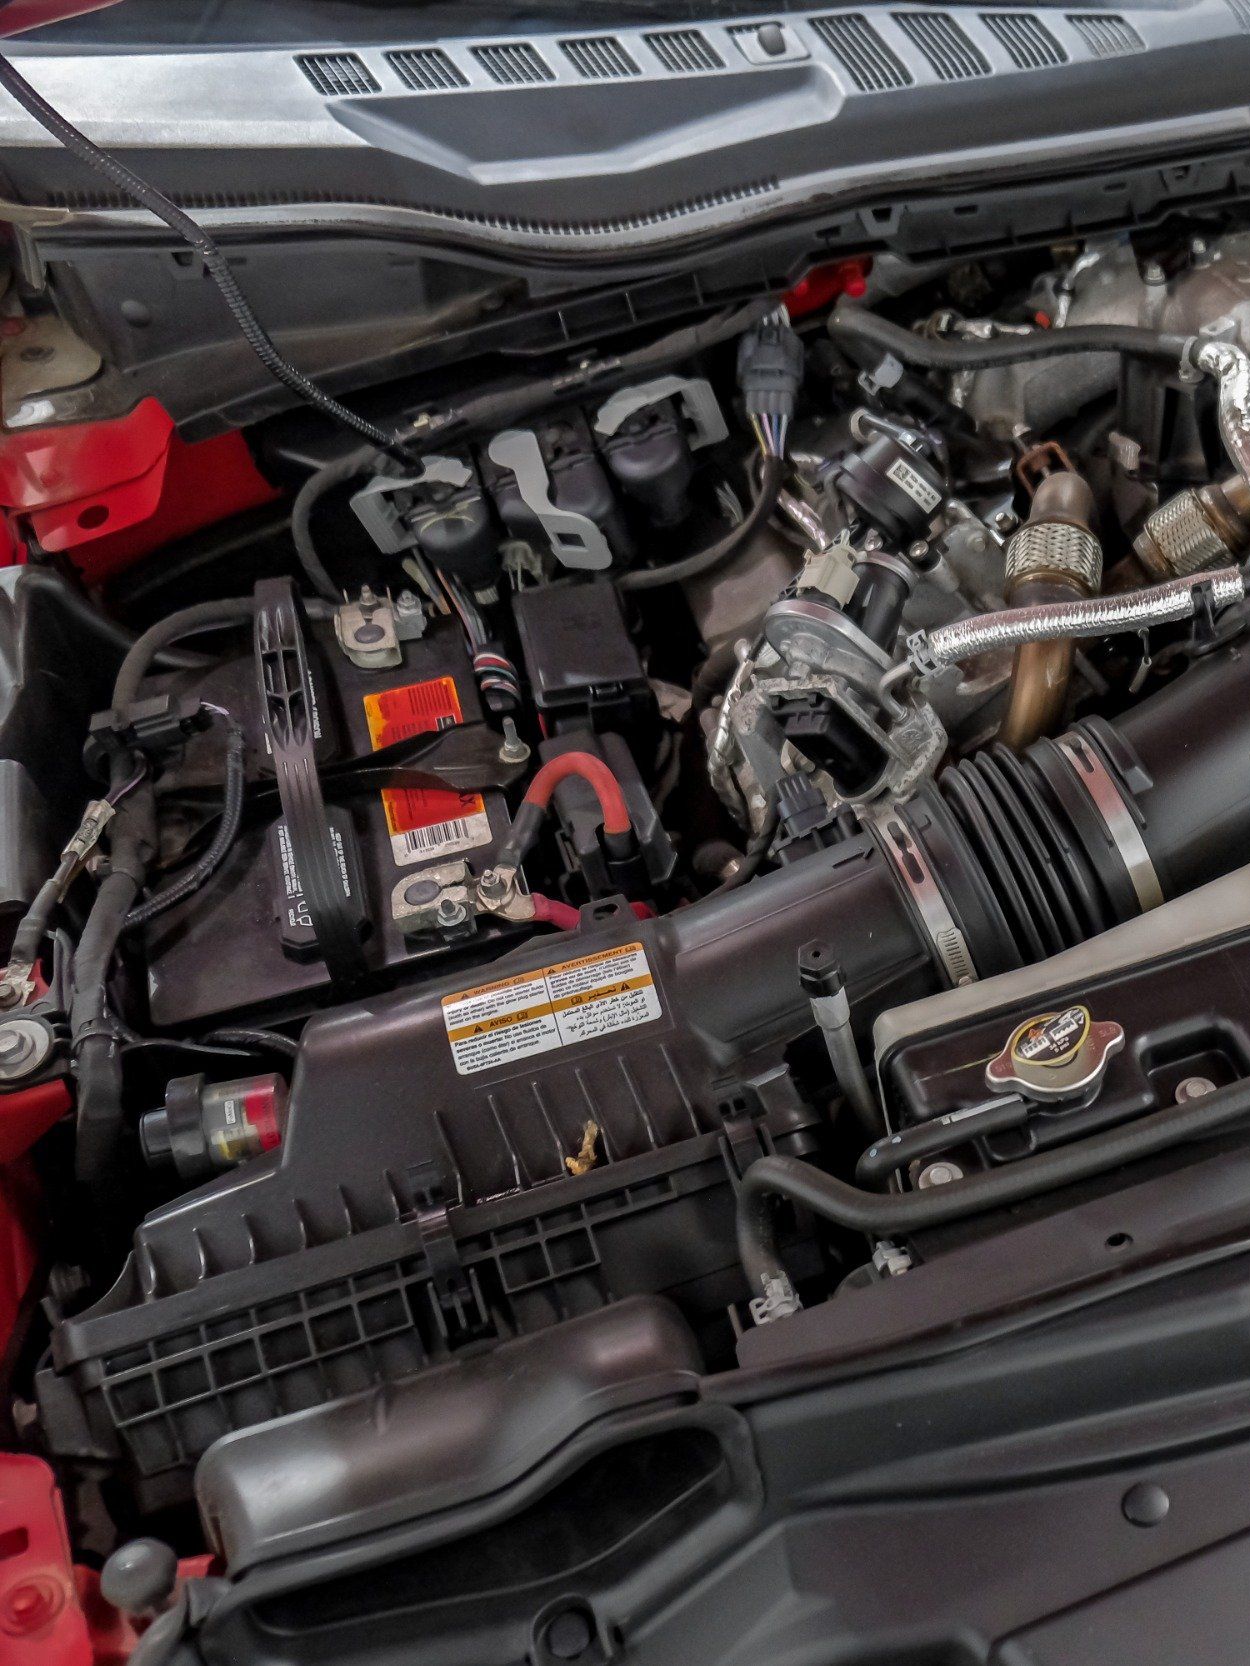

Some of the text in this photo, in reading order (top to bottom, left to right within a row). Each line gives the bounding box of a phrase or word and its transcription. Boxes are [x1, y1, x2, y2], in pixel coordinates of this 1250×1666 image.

[561, 950, 622, 970] AVERTISSEMENT
[474, 982, 510, 995] WARNING
[489, 1016, 513, 1027] AVISO
